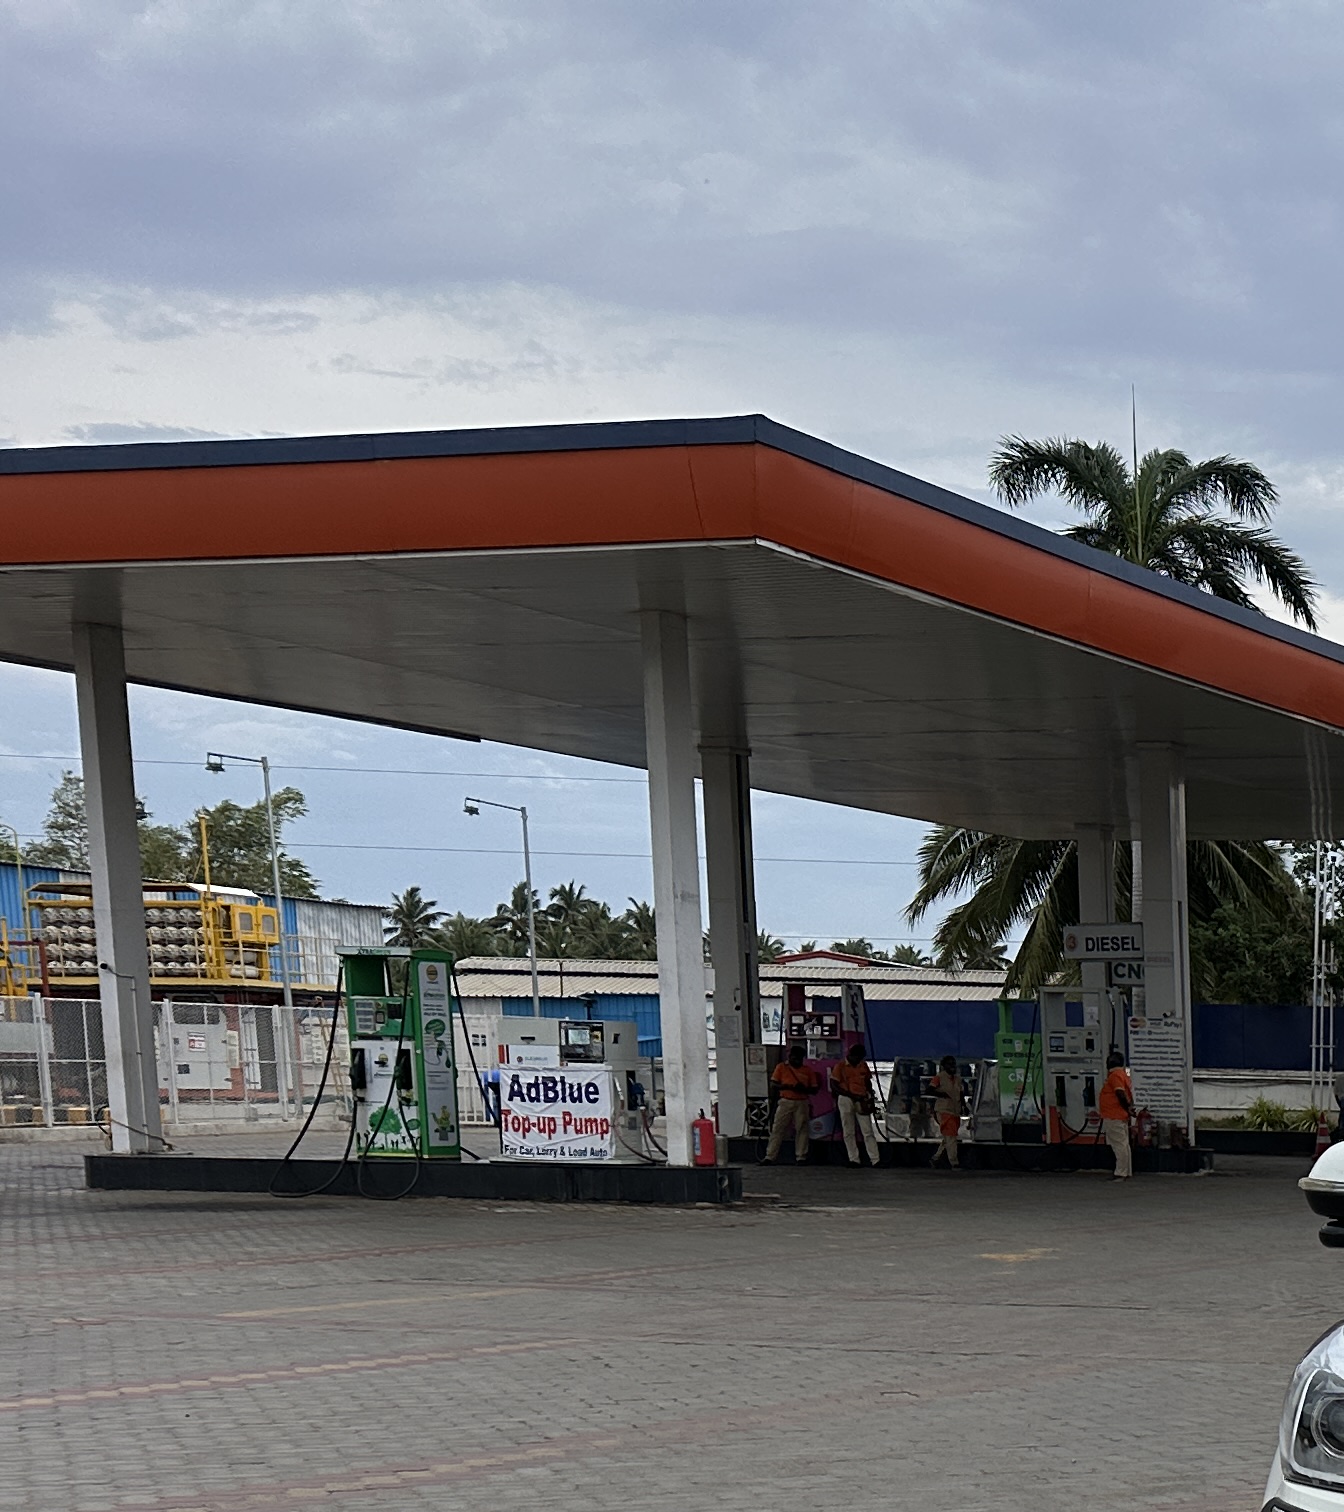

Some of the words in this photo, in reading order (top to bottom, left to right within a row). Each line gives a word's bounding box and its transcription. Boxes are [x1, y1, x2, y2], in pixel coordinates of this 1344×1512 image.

[1085, 936, 1141, 952] DIESEL
[1113, 962, 1144, 980] CN
[508, 1074, 600, 1104] AdBlue
[501, 1109, 557, 1140] Top-up
[562, 1111, 609, 1140] Pump
[504, 1145, 517, 1155] For
[536, 1146, 557, 1158] Lorry
[560, 1146, 566, 1157] &
[589, 1147, 608, 1157] Auto
